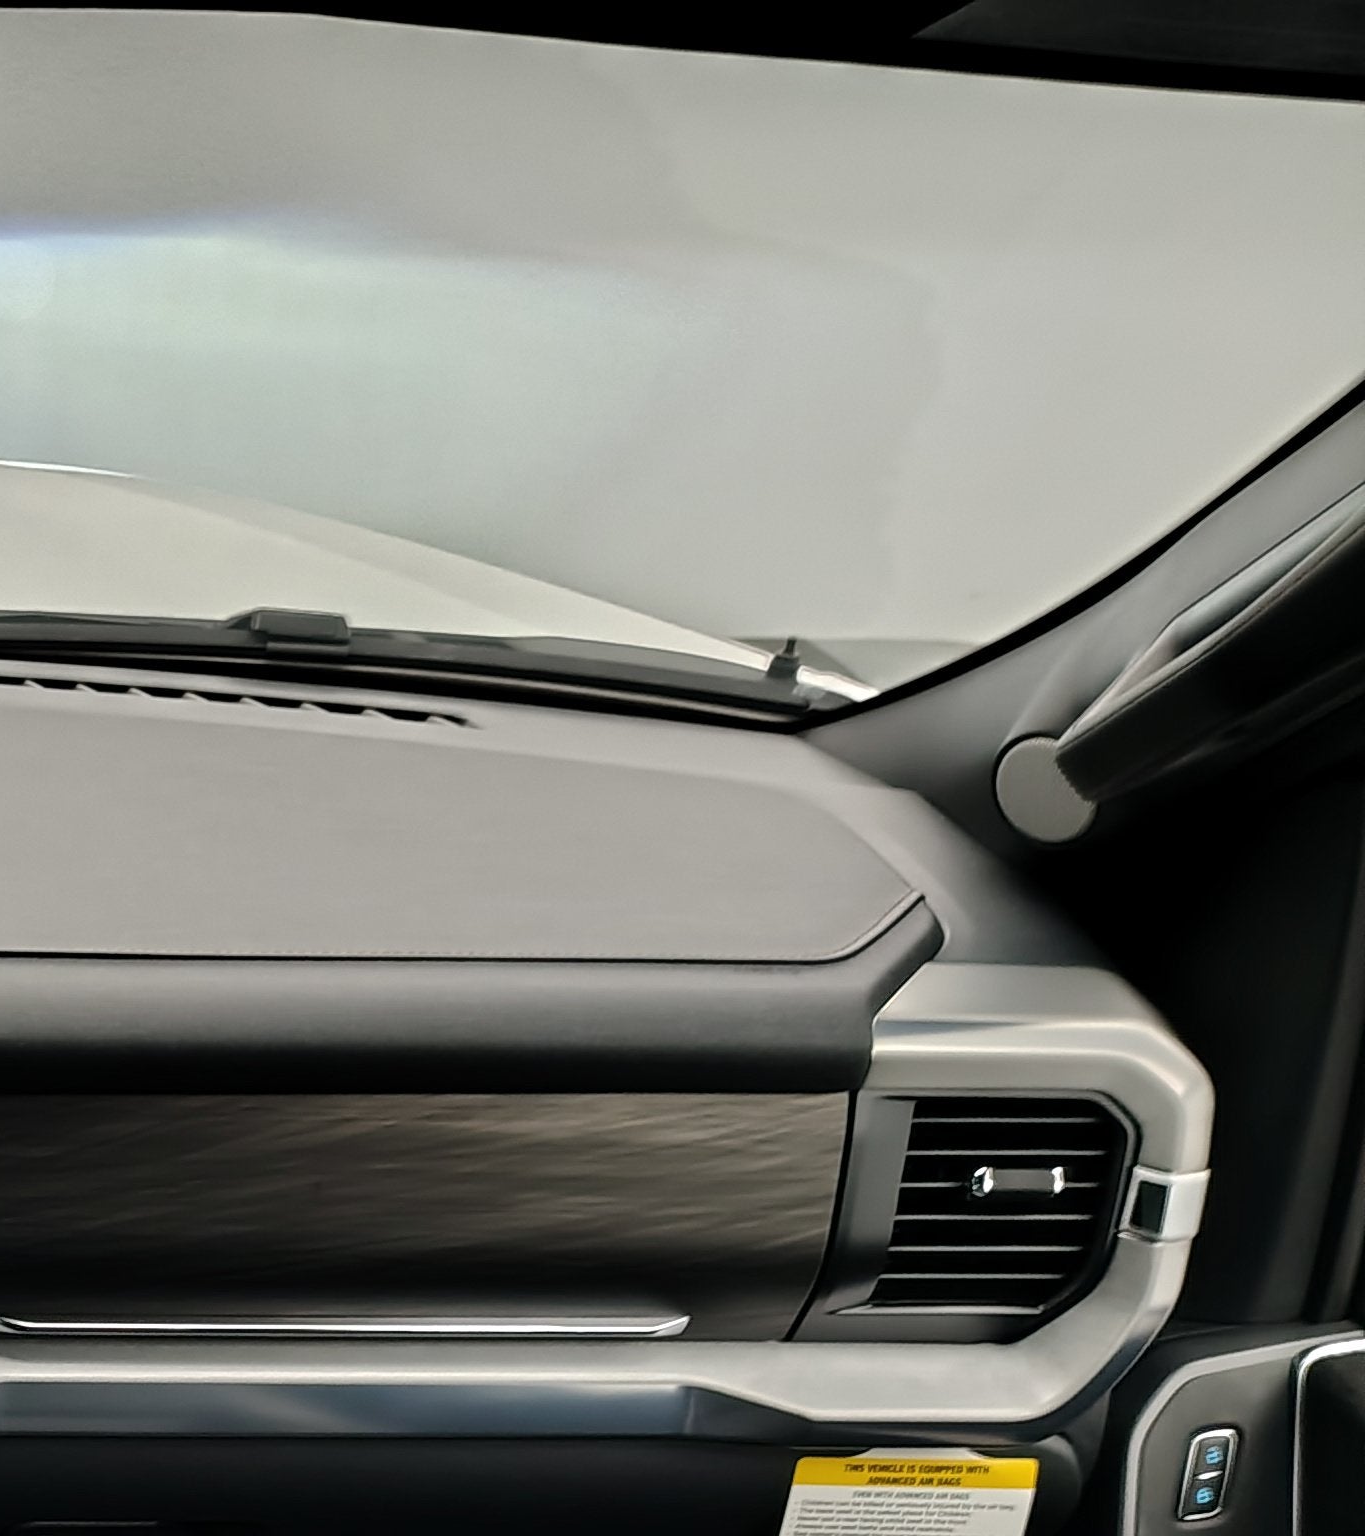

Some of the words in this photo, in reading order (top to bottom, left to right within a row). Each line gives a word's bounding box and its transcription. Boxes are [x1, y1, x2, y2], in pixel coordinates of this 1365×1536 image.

[867, 1464, 906, 1473] VEHICLE
[906, 1464, 916, 1474] IS
[918, 1464, 964, 1475] EQUIPPED
[965, 1465, 990, 1475] WITH
[866, 1476, 917, 1487] ADVANCED
[917, 1478, 934, 1487] AIR
